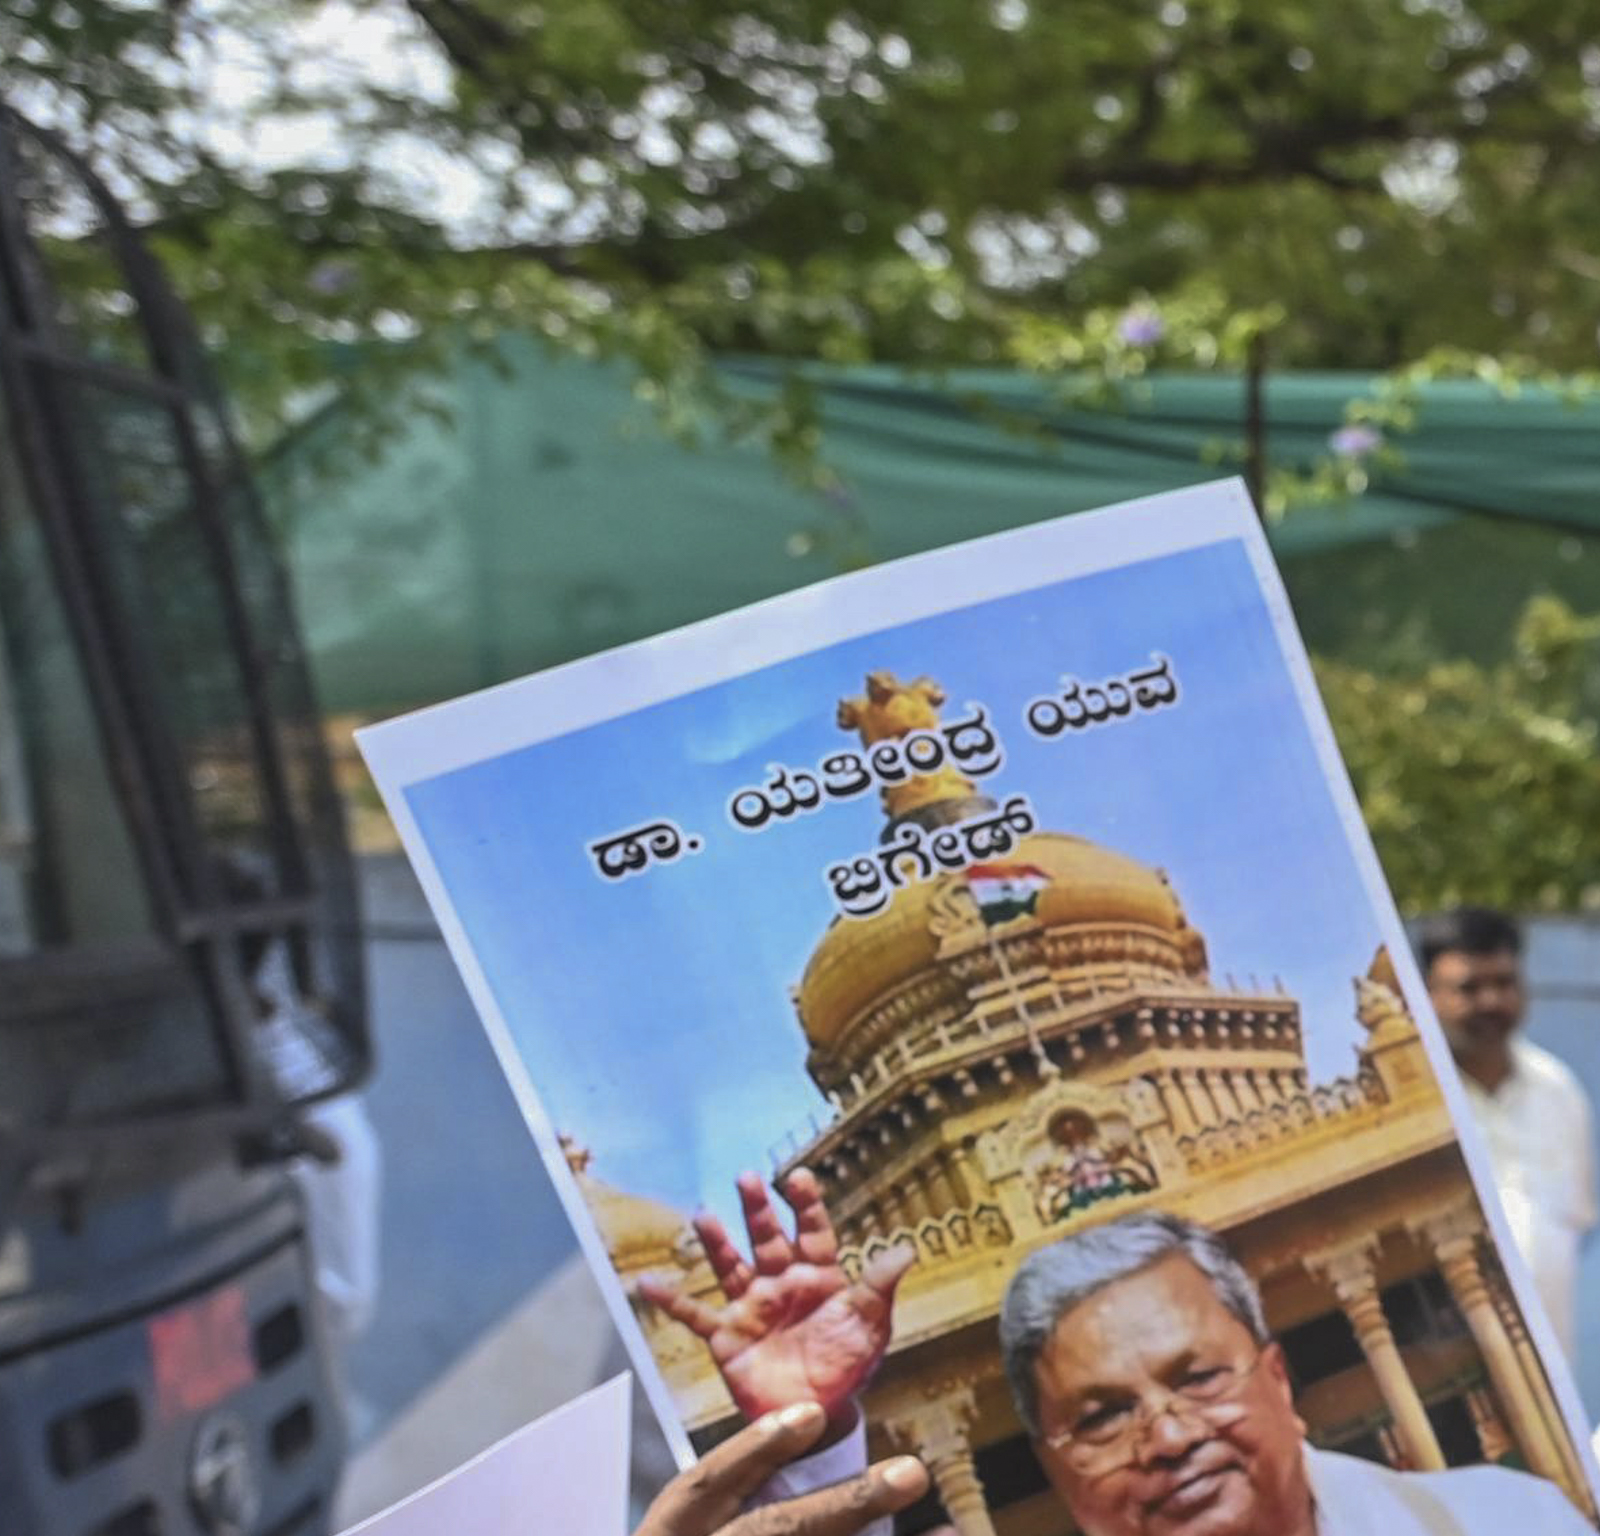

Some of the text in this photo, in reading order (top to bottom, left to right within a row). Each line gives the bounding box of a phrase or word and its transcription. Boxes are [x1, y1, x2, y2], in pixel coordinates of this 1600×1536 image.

[592, 657, 1179, 877] ಡಾ. ಯತೀಂದ್ರ ಯುವ
[827, 796, 1036, 914] ಬ್ರಿಗೇಡ್
